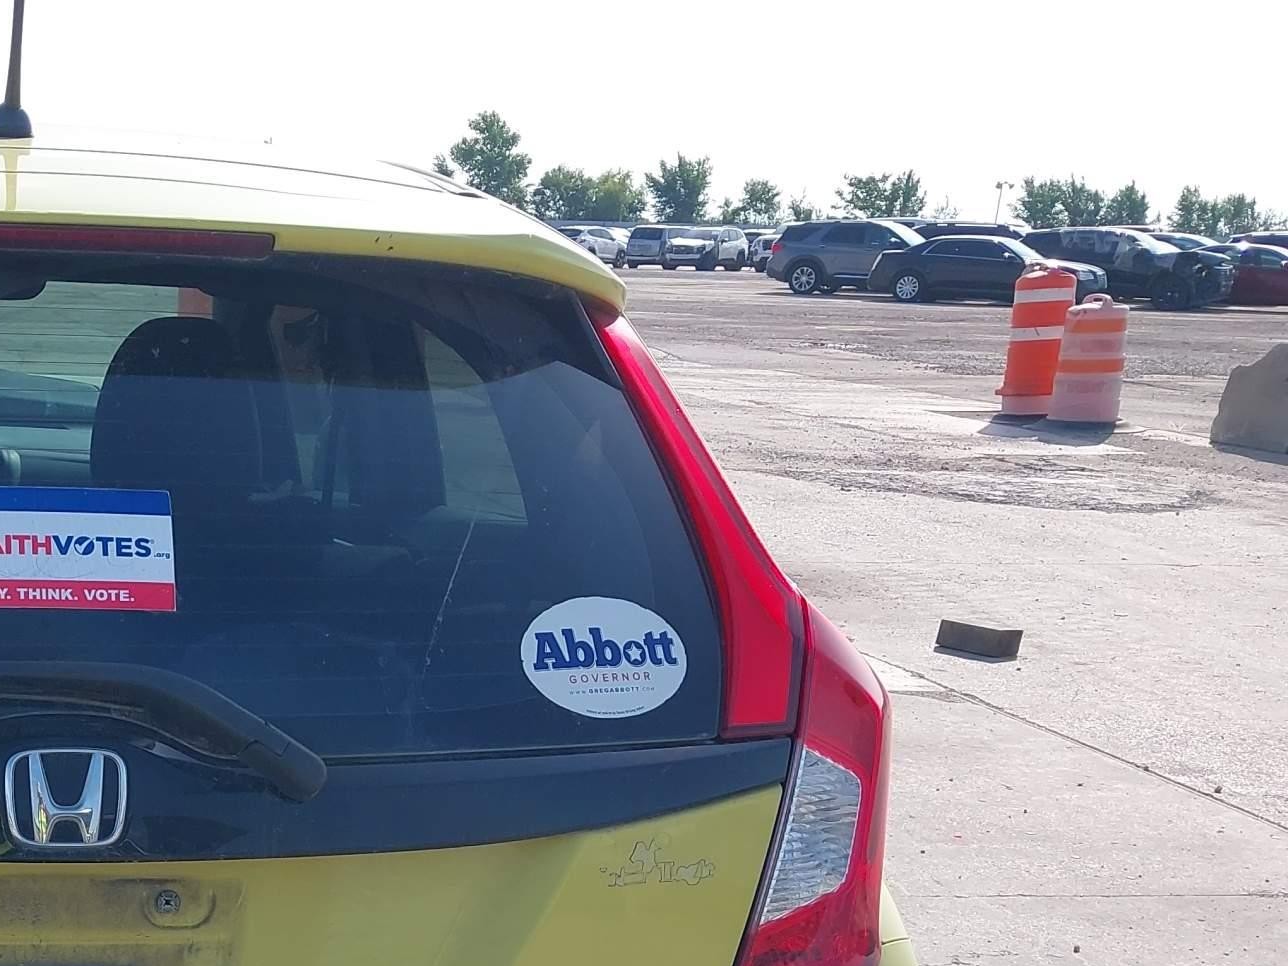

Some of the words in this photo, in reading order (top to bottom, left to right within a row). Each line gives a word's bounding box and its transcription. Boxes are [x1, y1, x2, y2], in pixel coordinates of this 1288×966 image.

[16, 587, 78, 601] THINK.
[84, 589, 135, 602] VOTE.
[533, 627, 677, 670] Abbott
[569, 671, 651, 684] GOVERNOR
